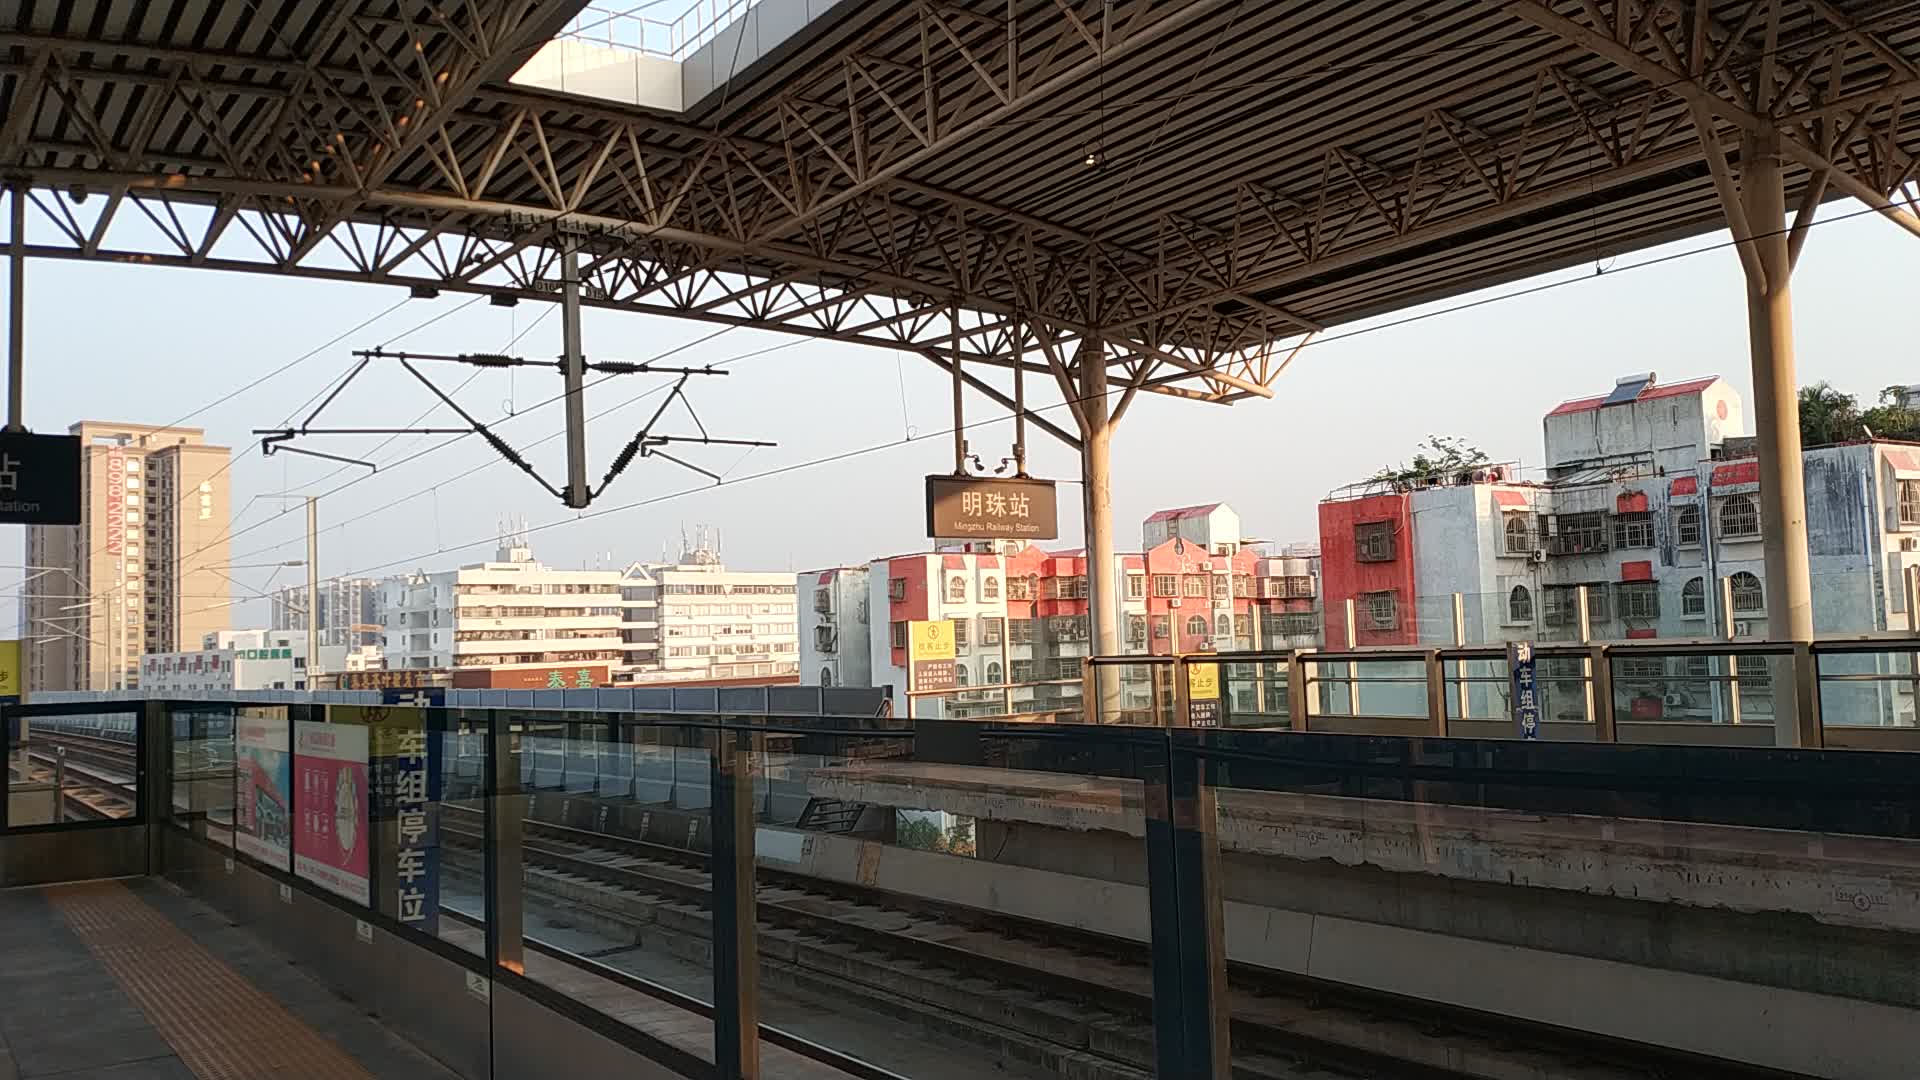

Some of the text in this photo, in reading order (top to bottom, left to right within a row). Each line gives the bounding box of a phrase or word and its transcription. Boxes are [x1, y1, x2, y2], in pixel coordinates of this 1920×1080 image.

[961, 491, 1031, 518] 明珠站
[954, 521, 1040, 534] Mingzhu Railway Station
[1517, 642, 1536, 740] 动车组停
